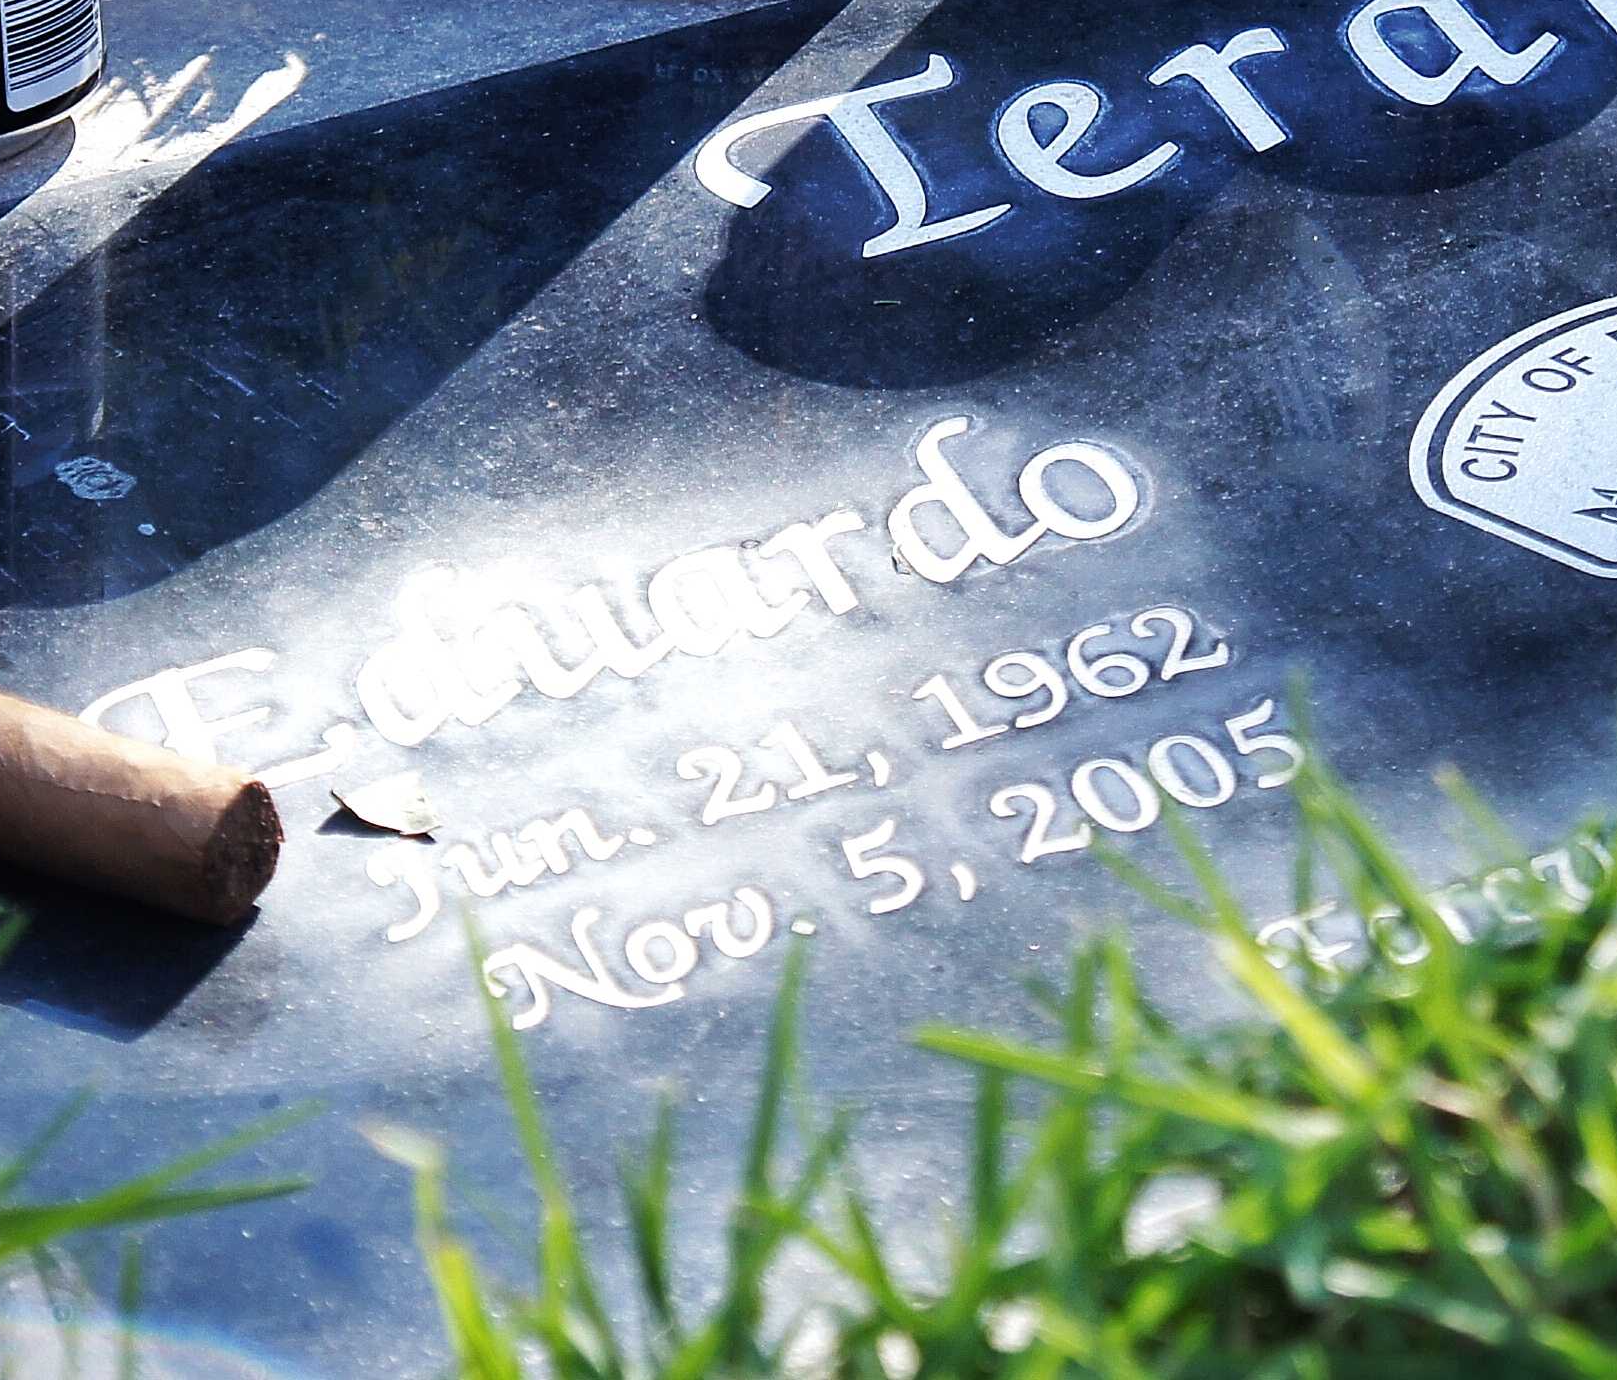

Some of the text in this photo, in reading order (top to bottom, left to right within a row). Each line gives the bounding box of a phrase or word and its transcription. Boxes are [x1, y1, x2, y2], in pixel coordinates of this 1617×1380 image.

[1460, 400, 1538, 483] CITY
[1522, 347, 1595, 393] OF
[81, 415, 1140, 786] Eduardo
[366, 606, 1230, 943] Jun. 21, 1962
[482, 697, 1305, 1031] Nov. 5, 2005
